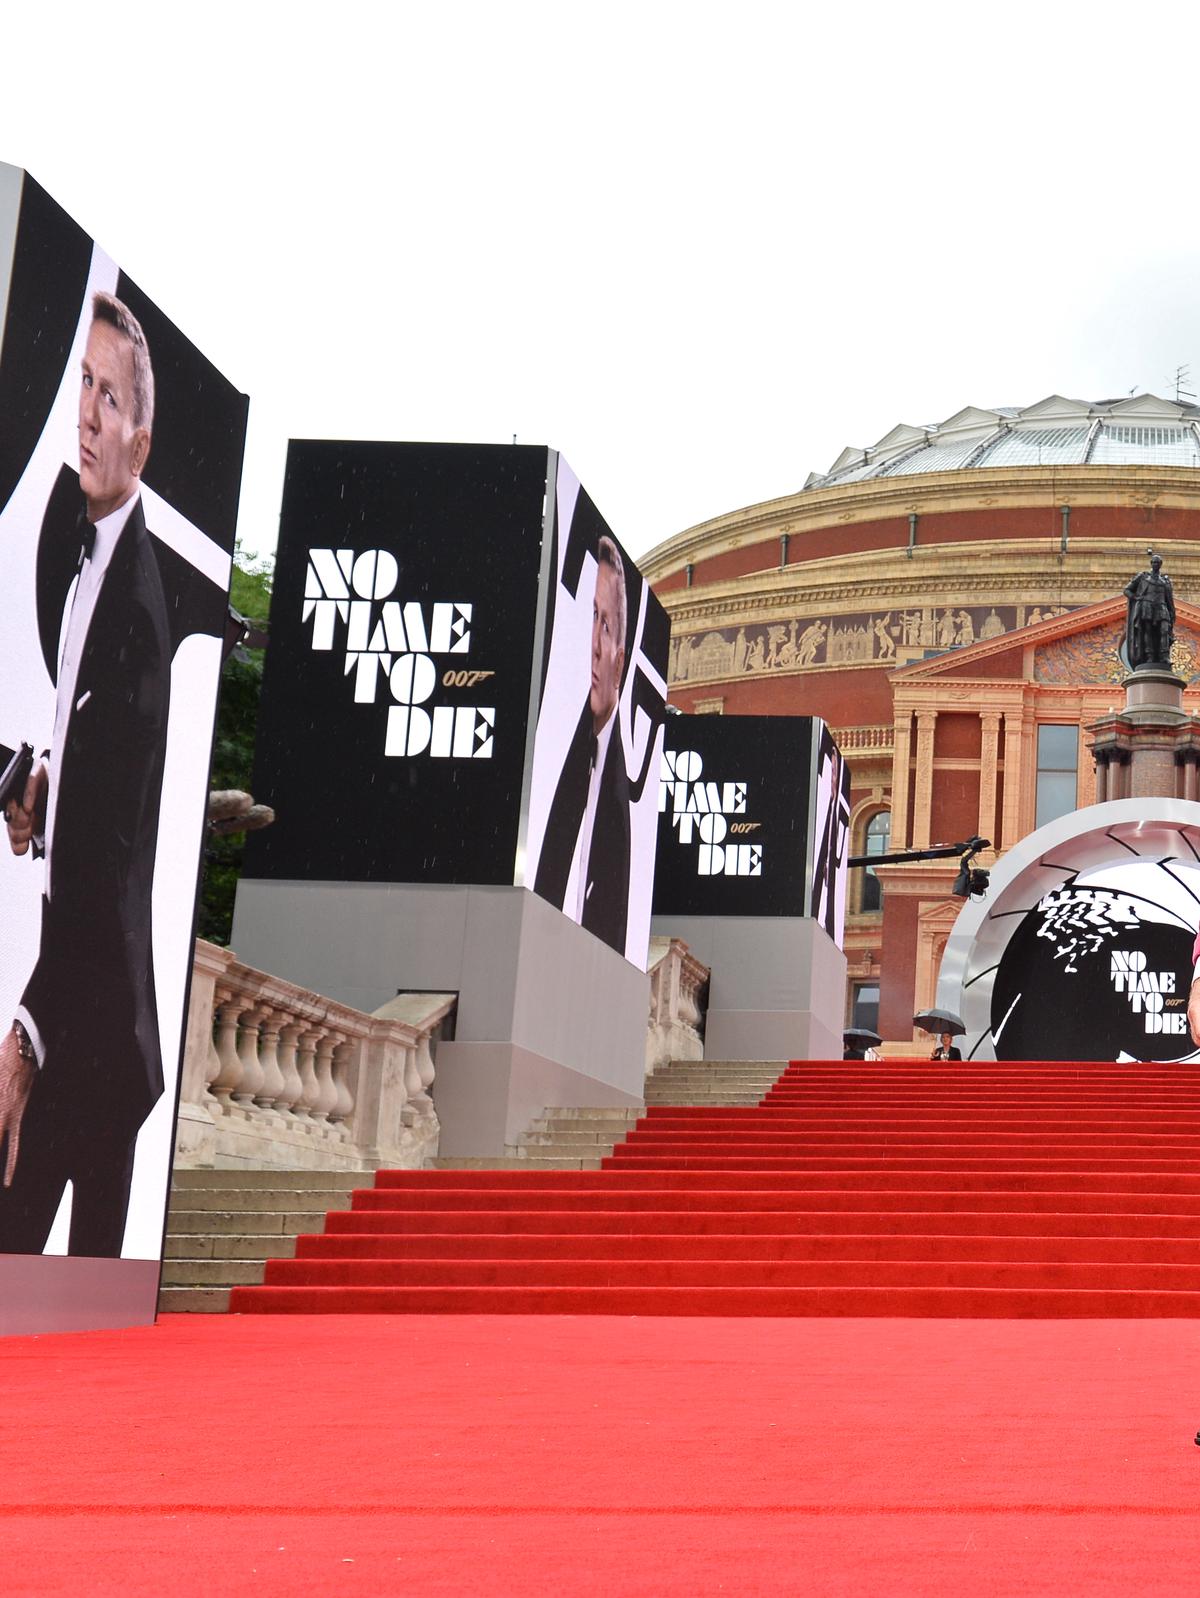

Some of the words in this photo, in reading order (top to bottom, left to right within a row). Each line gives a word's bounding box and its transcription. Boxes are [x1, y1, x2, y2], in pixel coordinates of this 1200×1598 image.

[304, 548, 398, 600] NO
[302, 600, 472, 653] TIME
[344, 652, 436, 705] TO
[442, 669, 495, 687] 007
[384, 706, 495, 759] DIE
[660, 750, 703, 782] NO
[658, 781, 747, 813] TIME
[672, 812, 727, 844] TO
[730, 822, 762, 834] 007
[698, 844, 762, 876] DIE
[1110, 950, 1147, 972] NO
[1110, 971, 1176, 993] TIME
[1127, 991, 1164, 1013] TO
[1165, 998, 1185, 1007] 007
[1145, 1012, 1187, 1034] DIE
